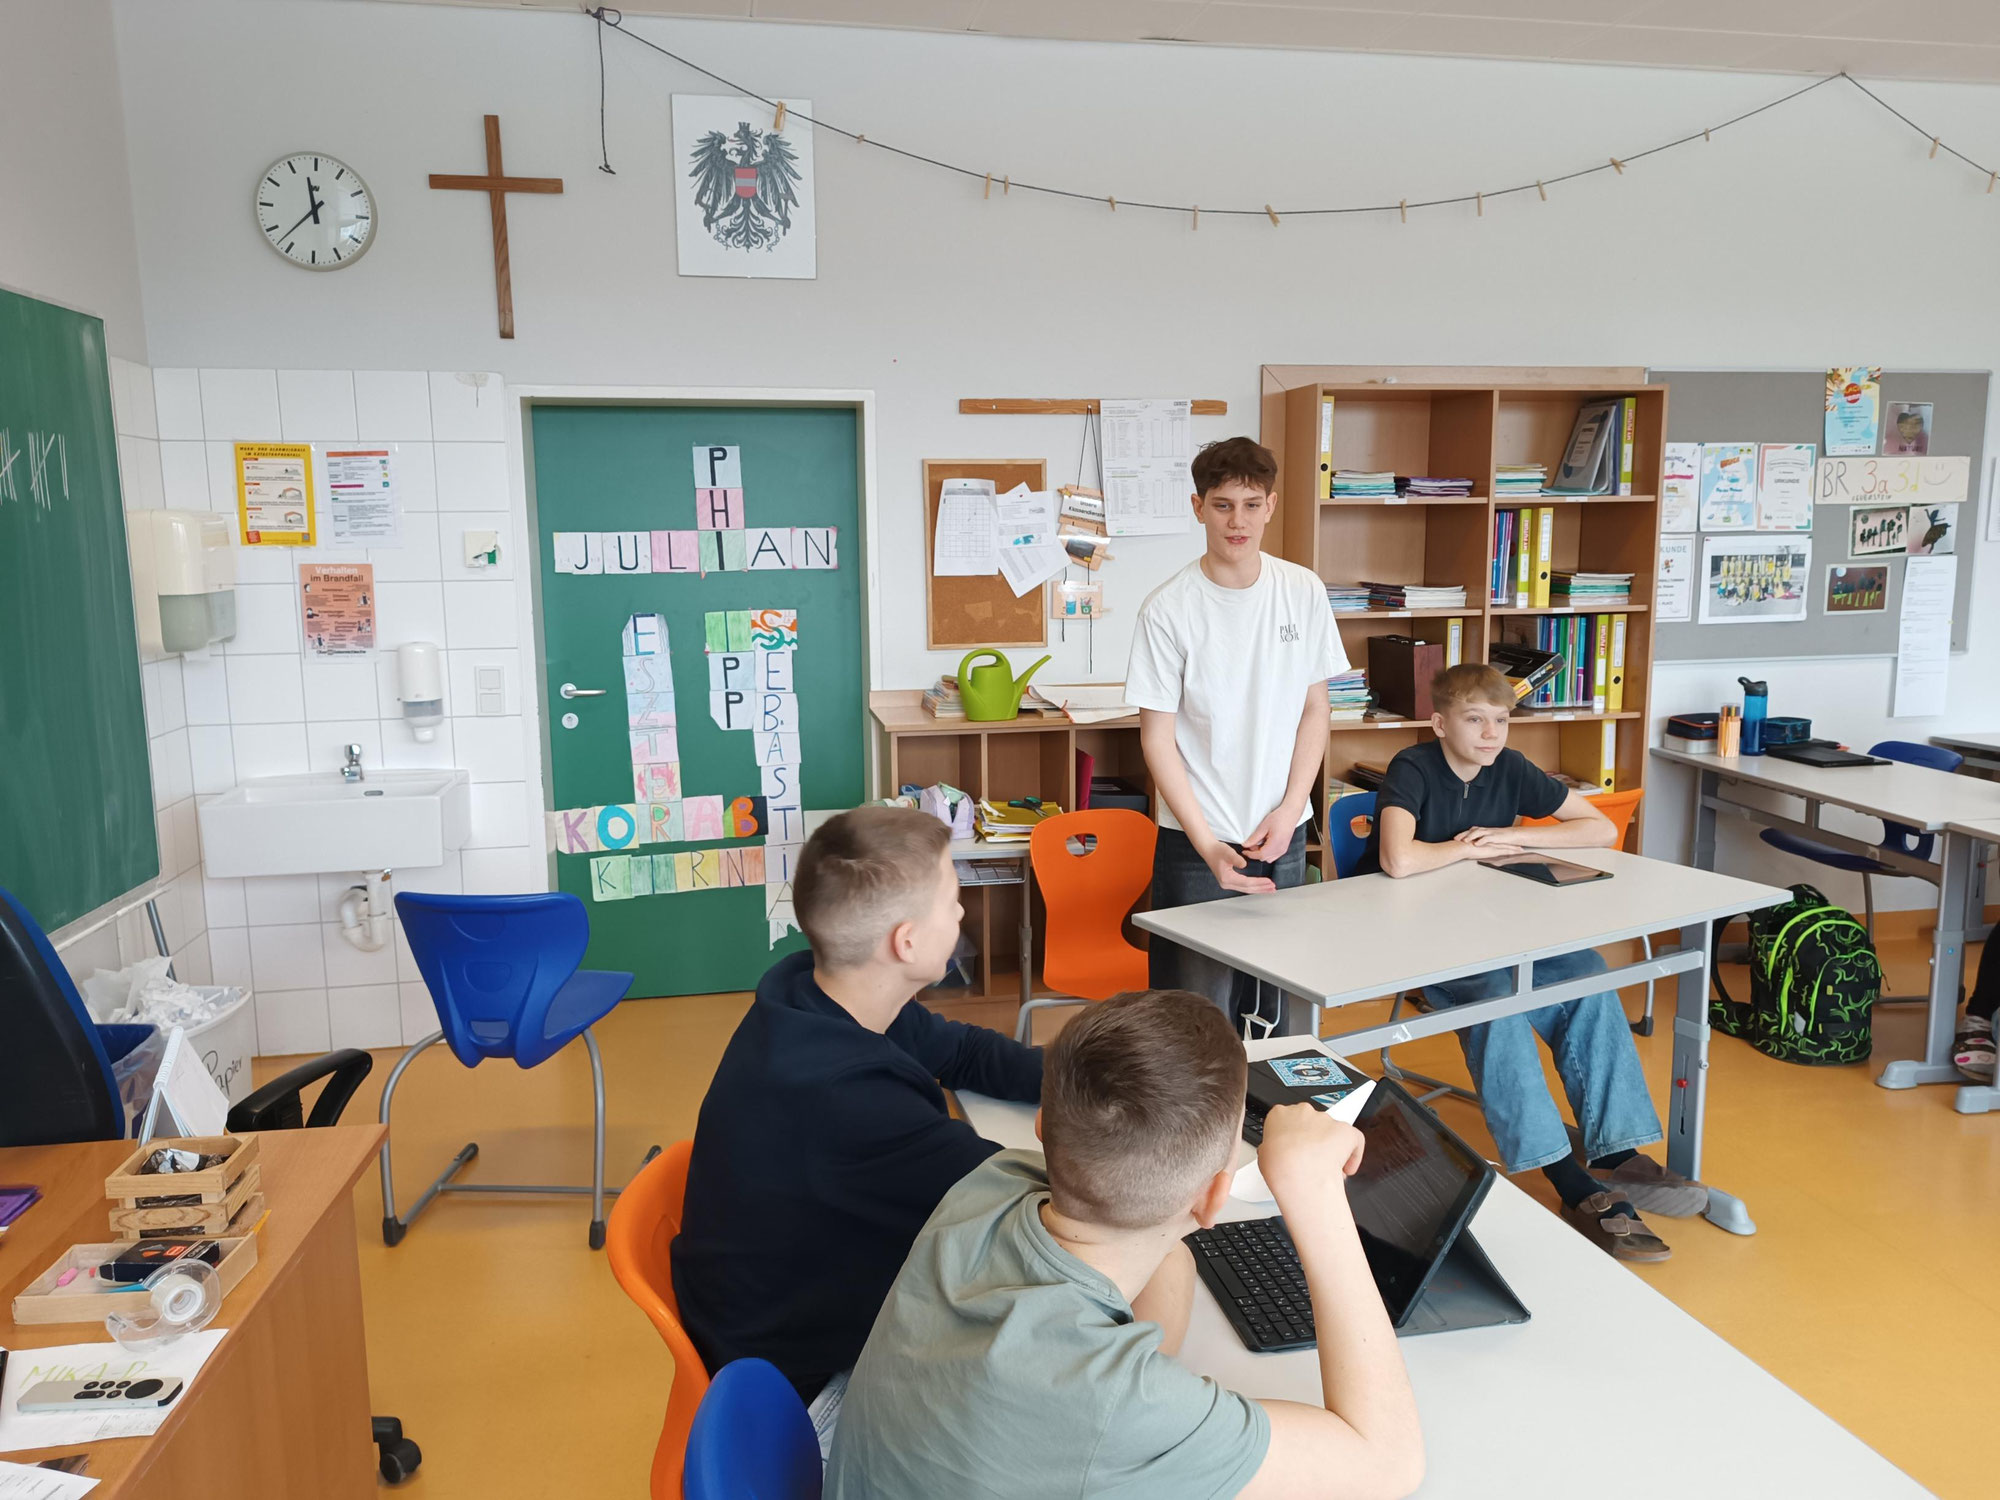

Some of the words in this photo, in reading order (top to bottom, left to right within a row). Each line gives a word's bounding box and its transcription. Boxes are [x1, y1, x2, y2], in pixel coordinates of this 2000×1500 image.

[1822, 460, 1849, 498] BR
[574, 529, 831, 571] JULIAN
[310, 574, 321, 582] im
[323, 574, 364, 583] Brandfall
[314, 566, 358, 575] Verhalten
[563, 796, 759, 853] KORAB
[202, 1050, 243, 1097] Papier
